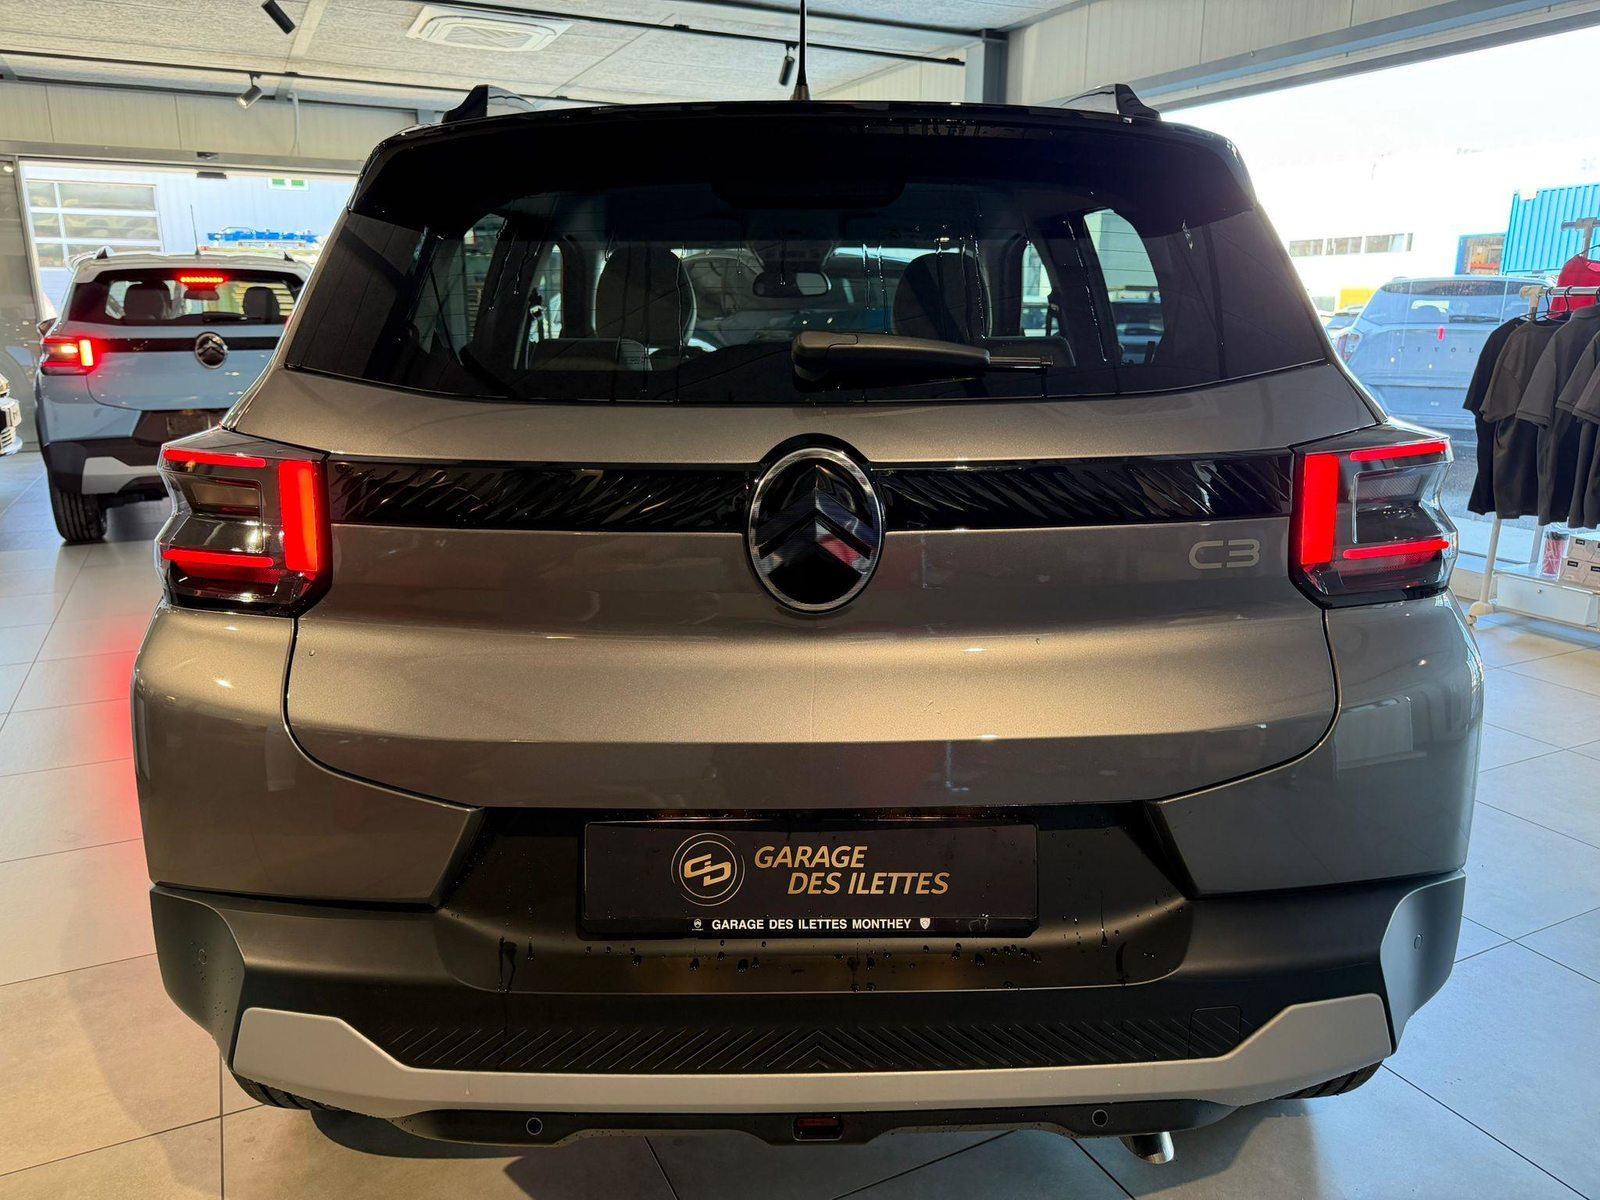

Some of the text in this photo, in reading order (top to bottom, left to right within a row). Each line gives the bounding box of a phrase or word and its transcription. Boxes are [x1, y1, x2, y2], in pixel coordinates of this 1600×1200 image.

[1188, 538, 1260, 570] C3
[754, 845, 868, 869] GARAGE
[787, 871, 950, 895] DES ILETTES
[711, 918, 912, 930] GARAGE DES ILETTES MONTHEY
